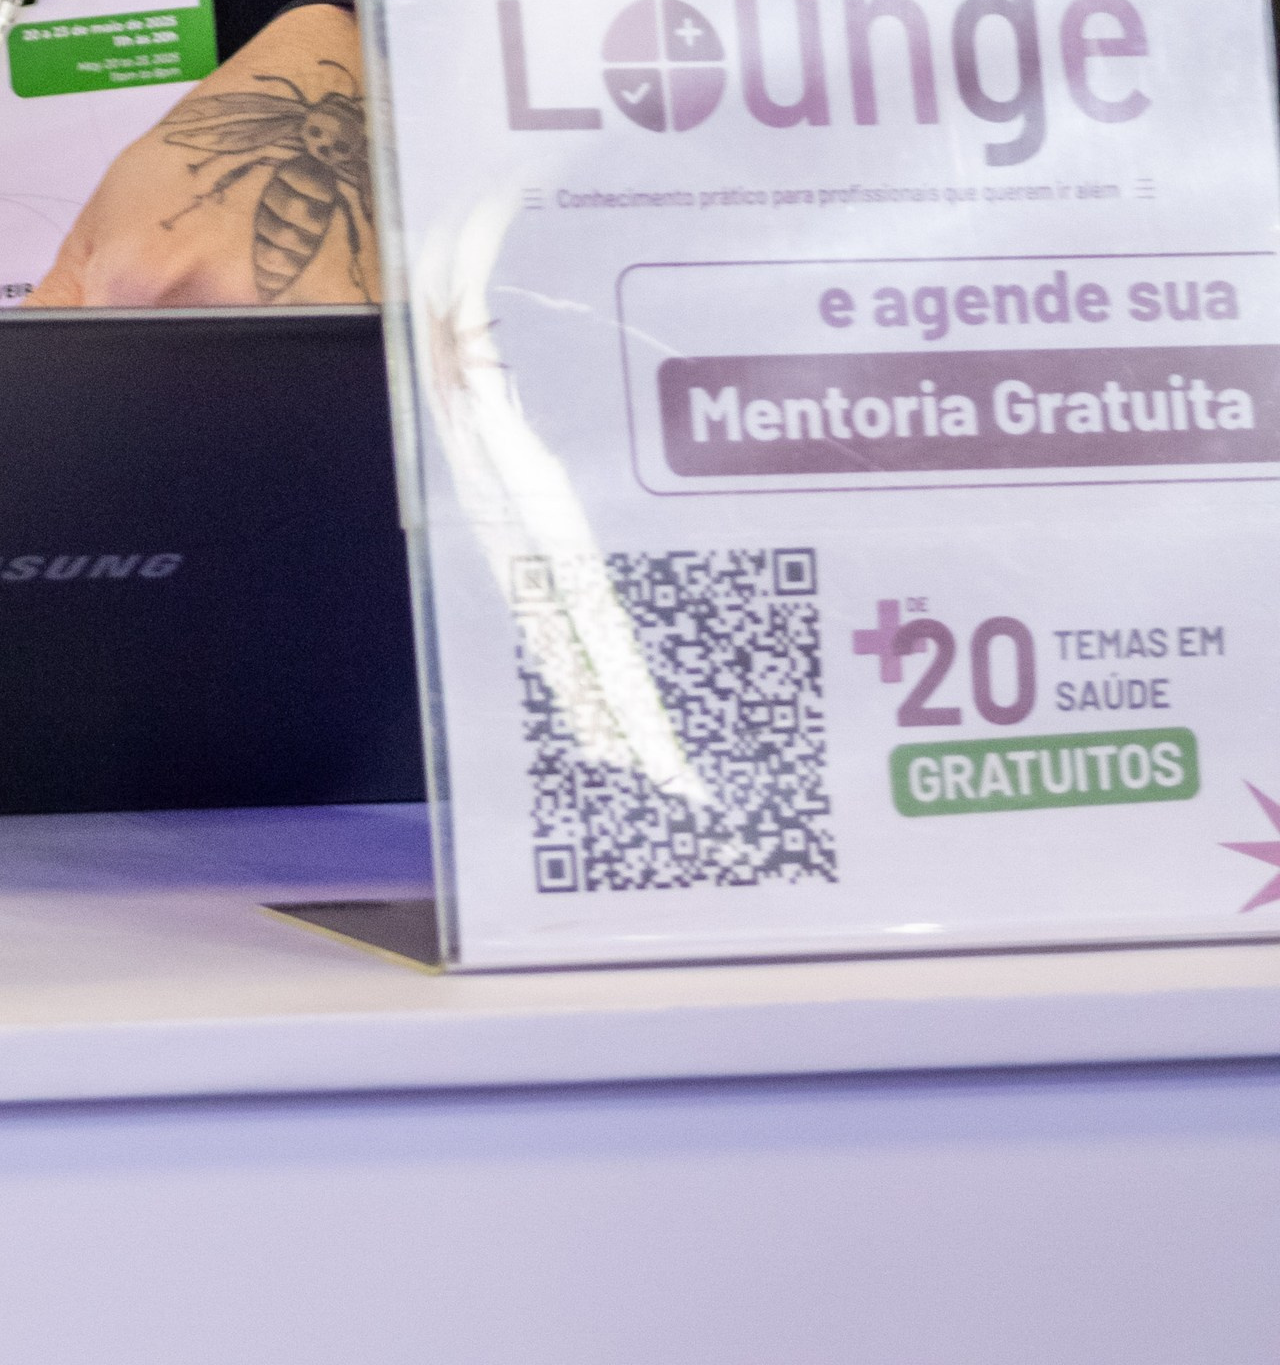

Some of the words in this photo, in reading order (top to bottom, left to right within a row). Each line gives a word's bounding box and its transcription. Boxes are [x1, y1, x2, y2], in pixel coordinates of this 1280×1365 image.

[556, 188, 694, 209] Conhecimento
[772, 189, 814, 210] para
[818, 183, 940, 208] profissionais
[944, 186, 978, 206] que
[983, 186, 1053, 205] querem
[1055, 181, 1070, 200] ir
[1073, 180, 1119, 200] além
[820, 287, 855, 329] e
[873, 269, 1111, 341] agende
[1127, 279, 1240, 323] sua
[688, 379, 979, 443] Mentoria
[992, 373, 1256, 435] Gratuita
[906, 596, 928, 612] DE
[1053, 627, 1169, 661] TEMAS
[1177, 625, 1224, 658] EM
[1056, 672, 1171, 711] SAÚDE
[908, 742, 1185, 802] GRATUITOS
